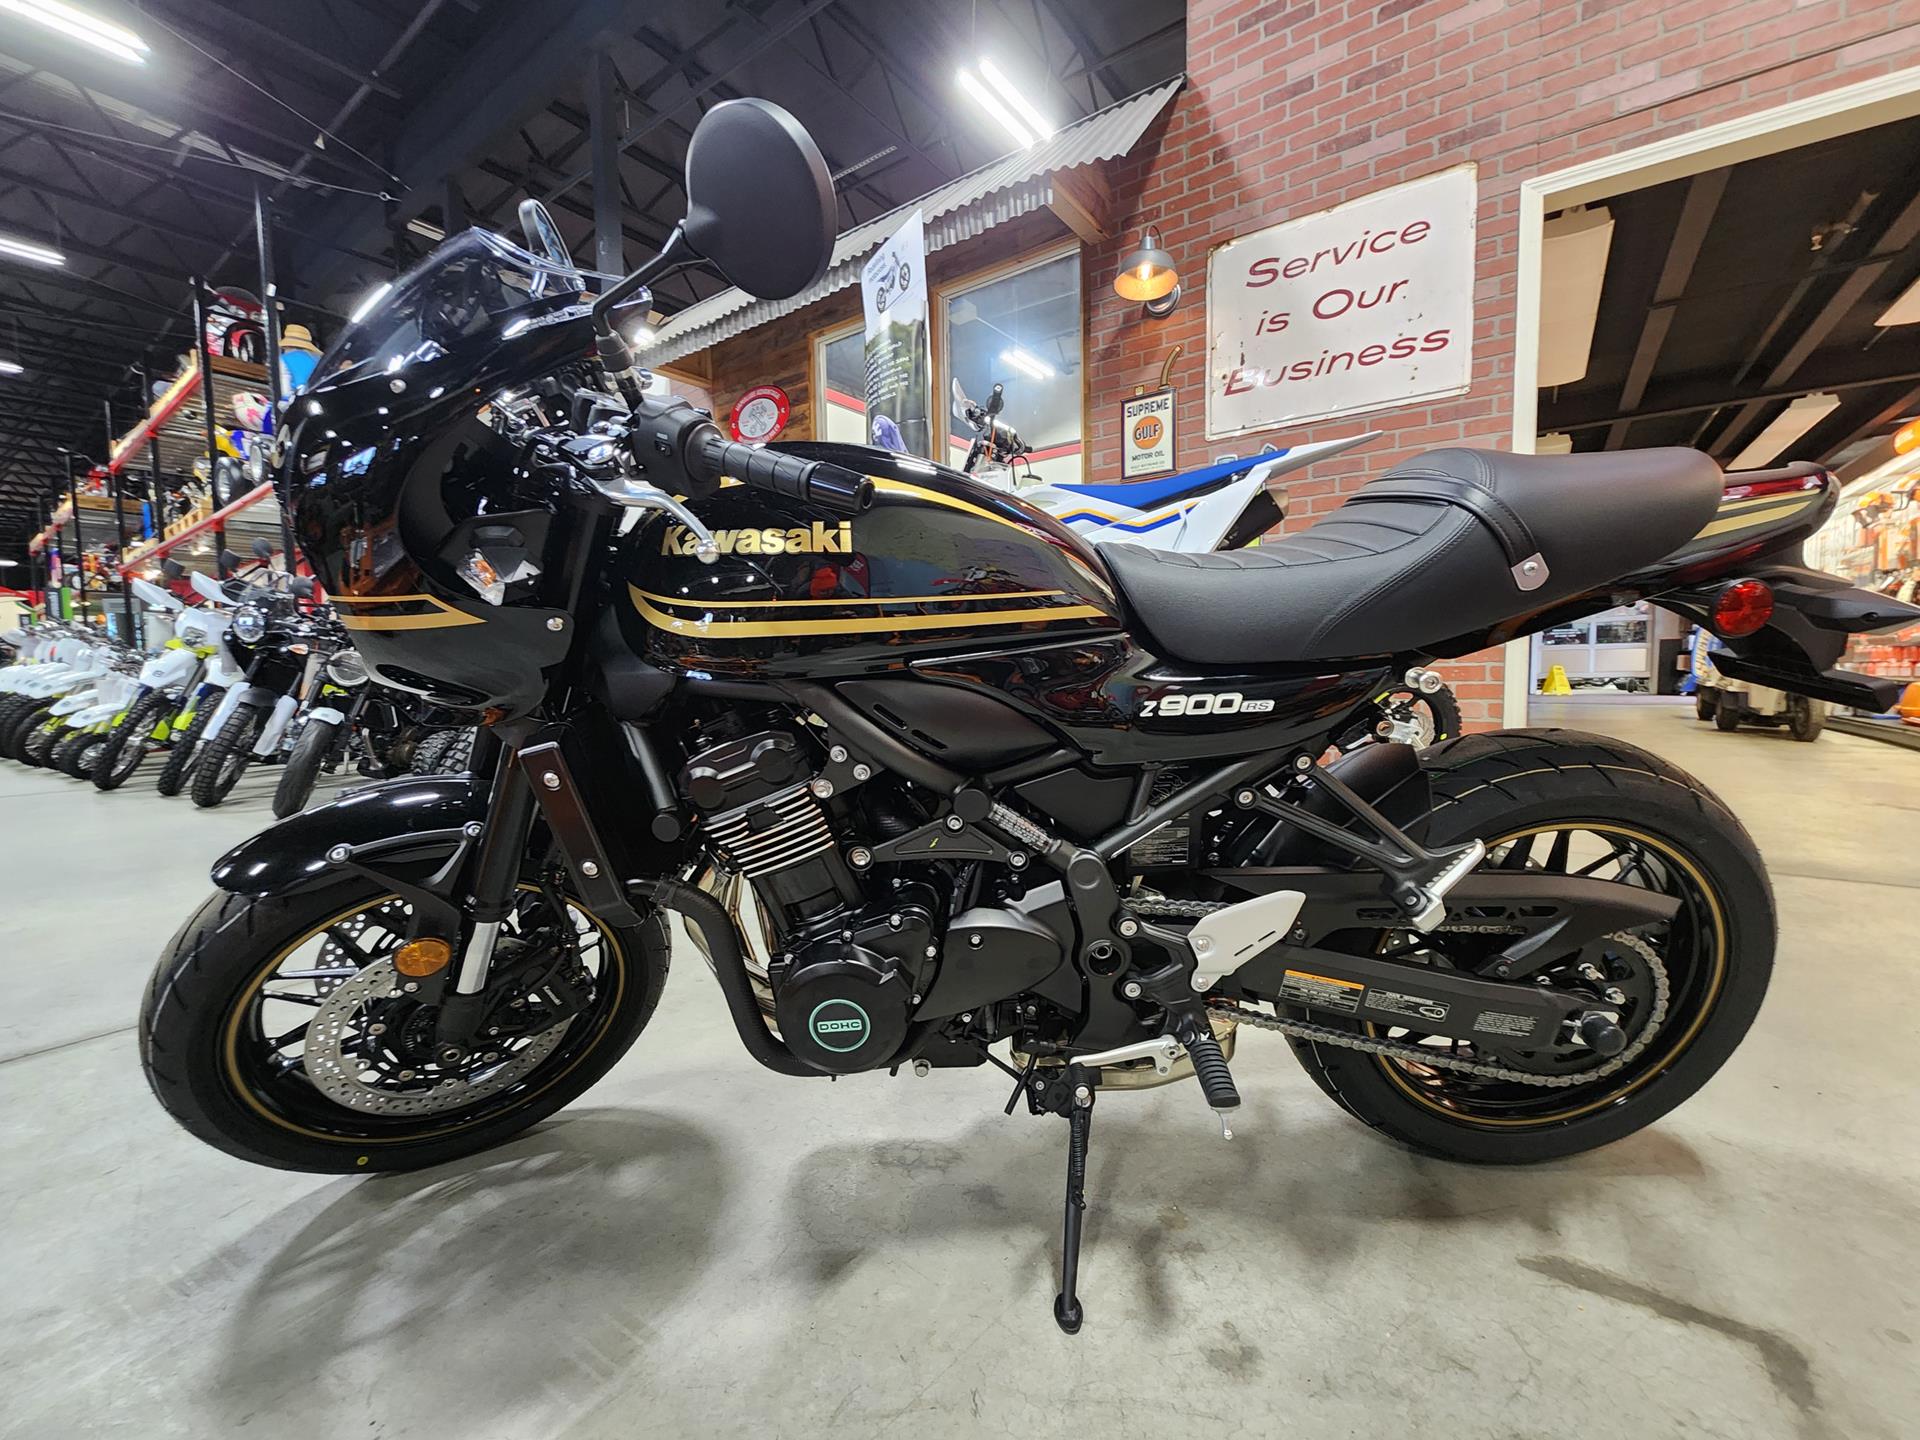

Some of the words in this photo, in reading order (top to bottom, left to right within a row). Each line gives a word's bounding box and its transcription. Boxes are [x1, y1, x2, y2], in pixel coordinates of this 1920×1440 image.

[1246, 220, 1431, 288] Service
[1255, 310, 1291, 336] is
[1312, 279, 1410, 319] Our
[1223, 329, 1451, 396] Business
[1127, 398, 1169, 417] SUPREME
[1134, 423, 1160, 440] GULF
[1131, 453, 1153, 461] MOTOR
[661, 521, 853, 556] Kawasaki
[819, 1021, 860, 1030] DOHC
